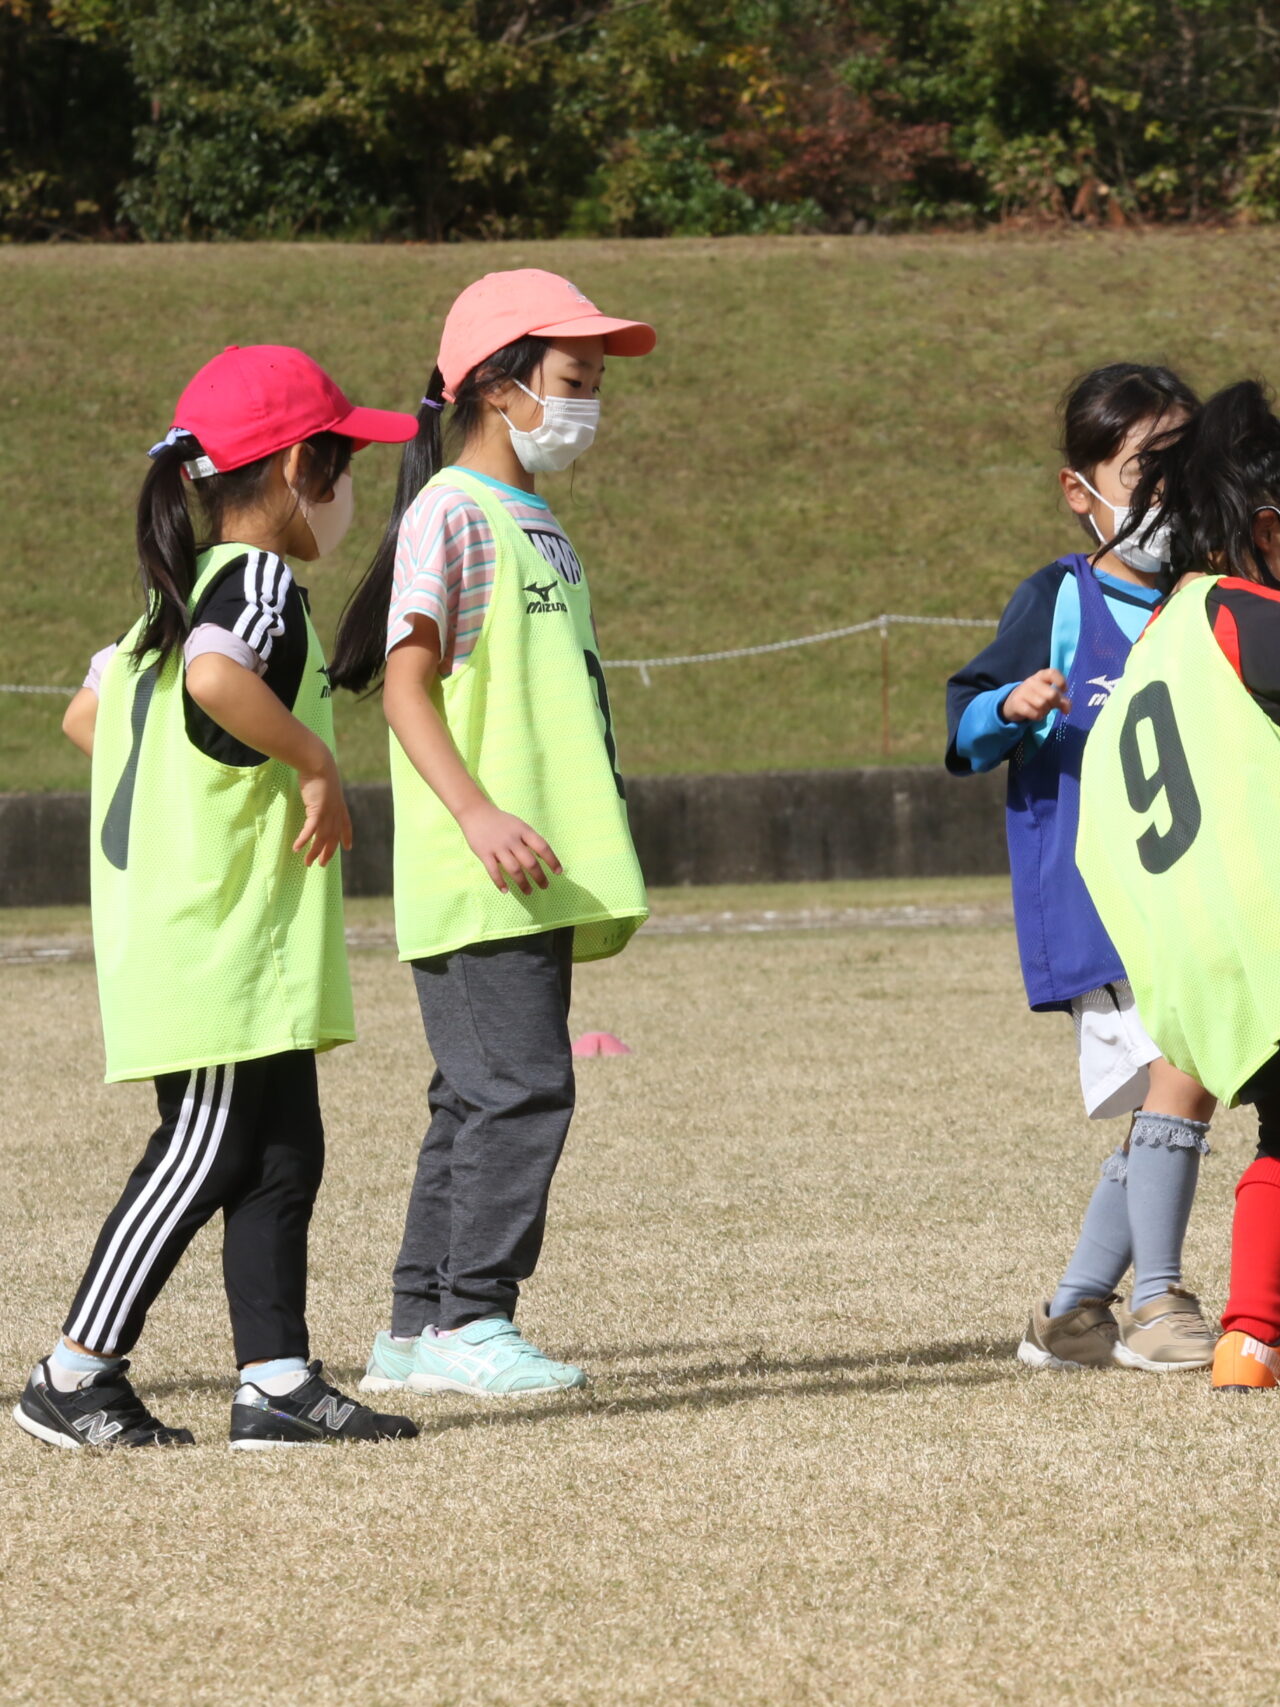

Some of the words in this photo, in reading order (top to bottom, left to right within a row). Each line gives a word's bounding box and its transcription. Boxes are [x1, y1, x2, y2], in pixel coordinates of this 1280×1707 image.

[1119, 680, 1202, 874] 9
[71, 1409, 123, 1446] N
[307, 1394, 356, 1431] N
